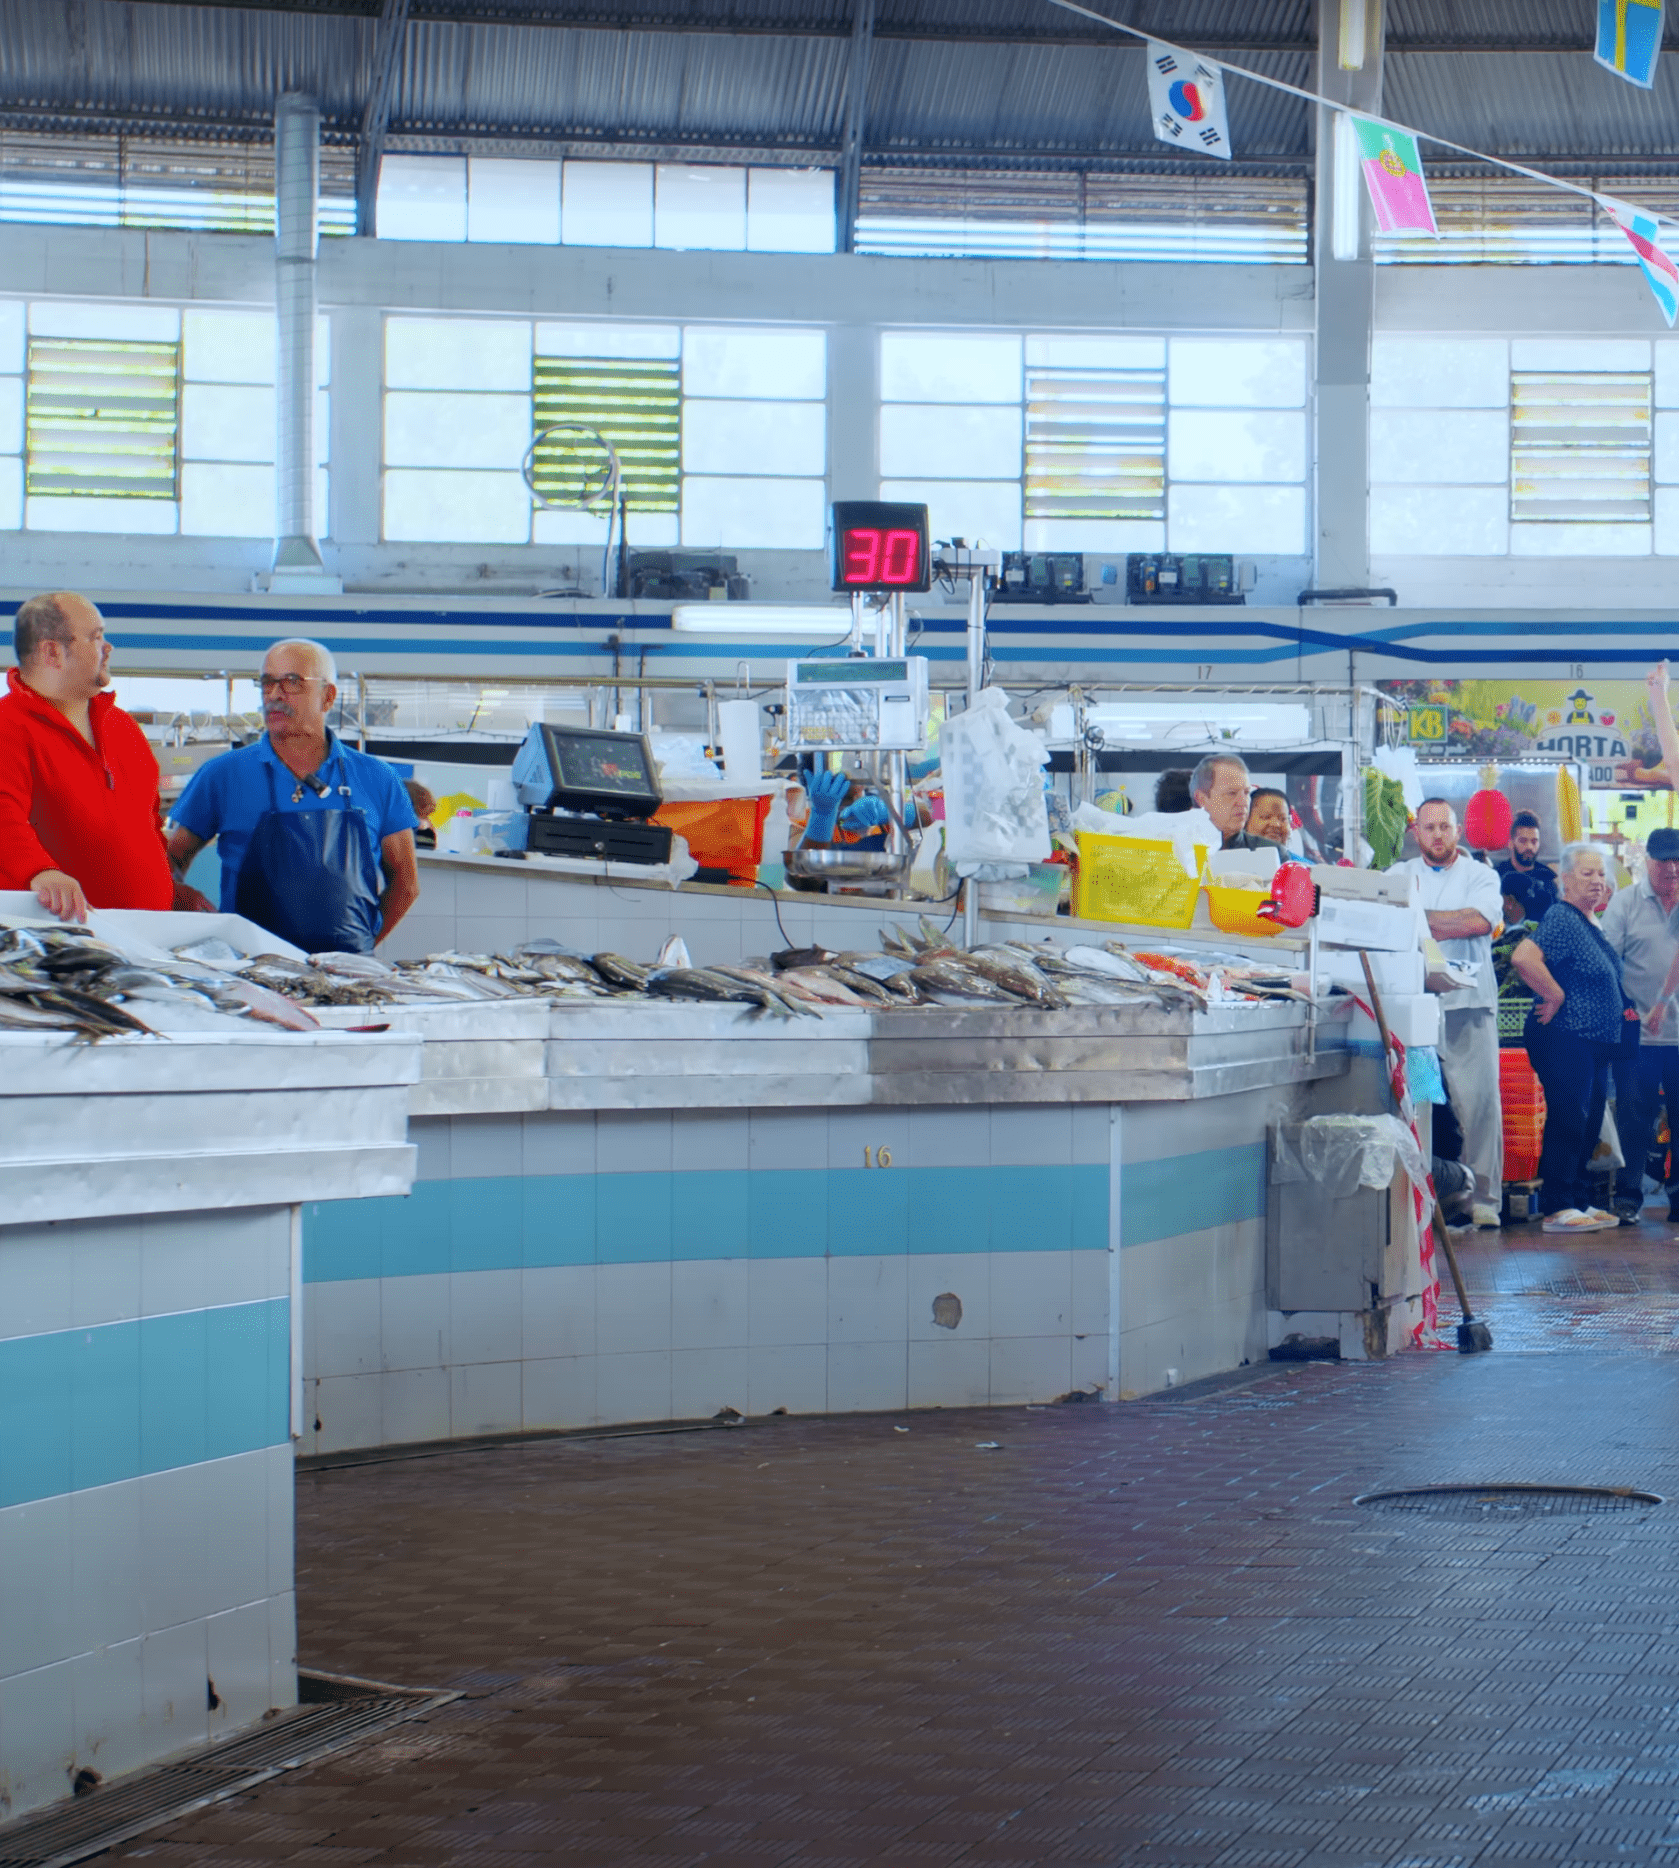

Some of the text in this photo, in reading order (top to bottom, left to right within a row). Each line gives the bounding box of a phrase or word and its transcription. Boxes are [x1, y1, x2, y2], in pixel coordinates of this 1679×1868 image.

[846, 530, 917, 582] 30
[1198, 665, 1212, 679] 17
[1570, 664, 1583, 679] 16
[1411, 708, 1443, 739] KB
[1536, 734, 1627, 757] HORTA
[863, 1145, 891, 1169] 16
